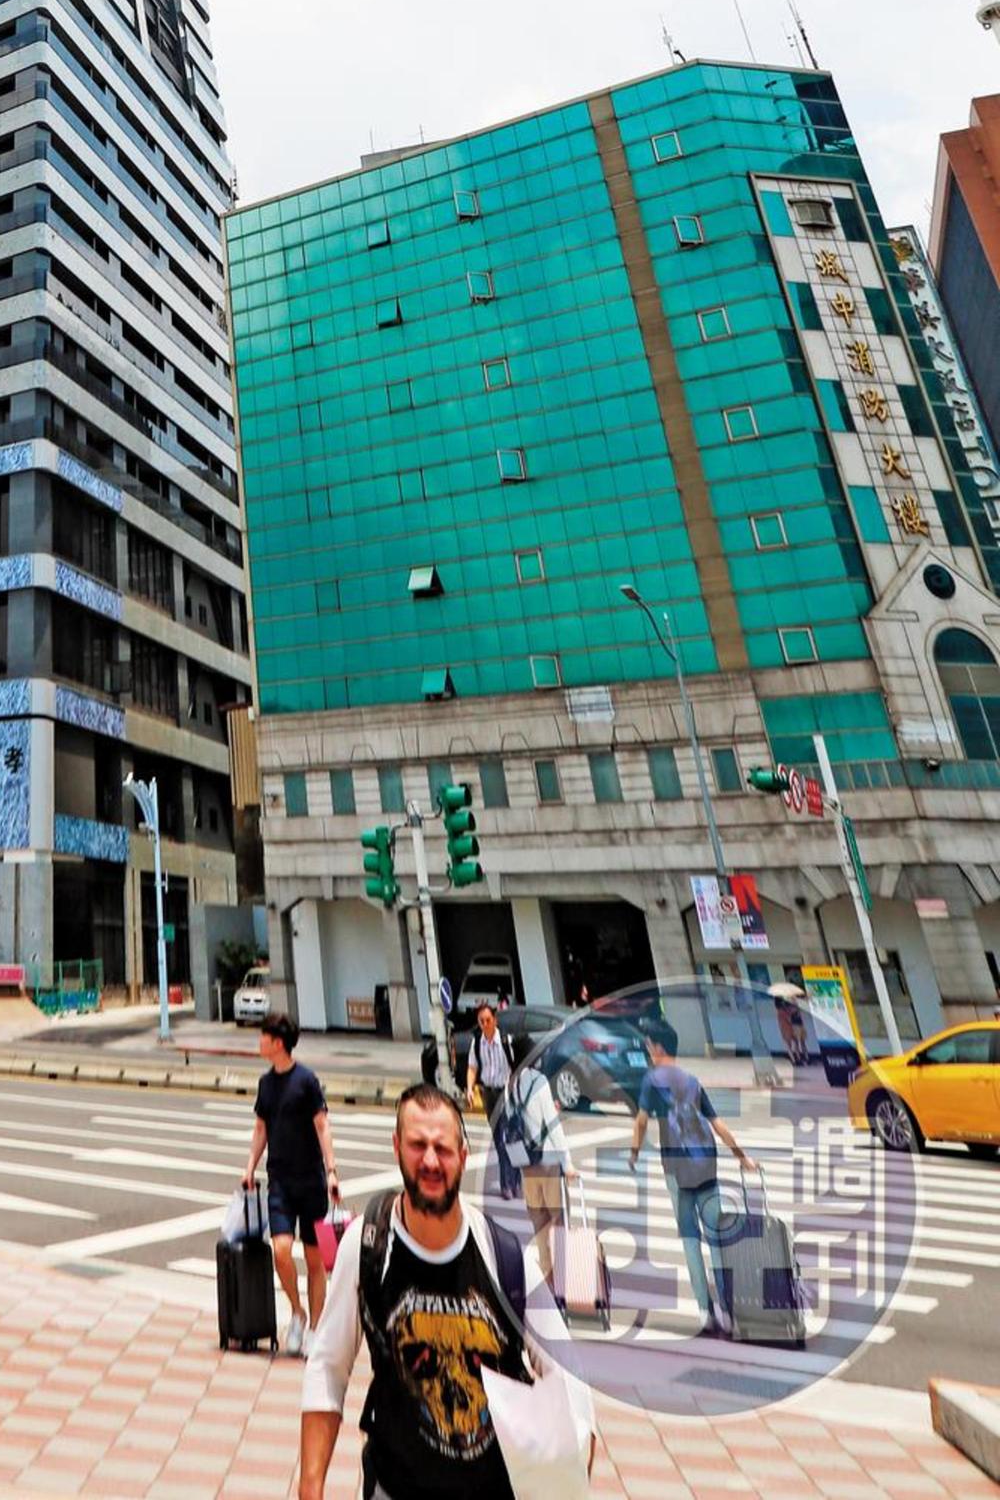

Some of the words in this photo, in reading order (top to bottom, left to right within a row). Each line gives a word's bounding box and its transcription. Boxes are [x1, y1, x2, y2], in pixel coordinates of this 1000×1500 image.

[815, 249, 929, 538] 城中消防大樓
